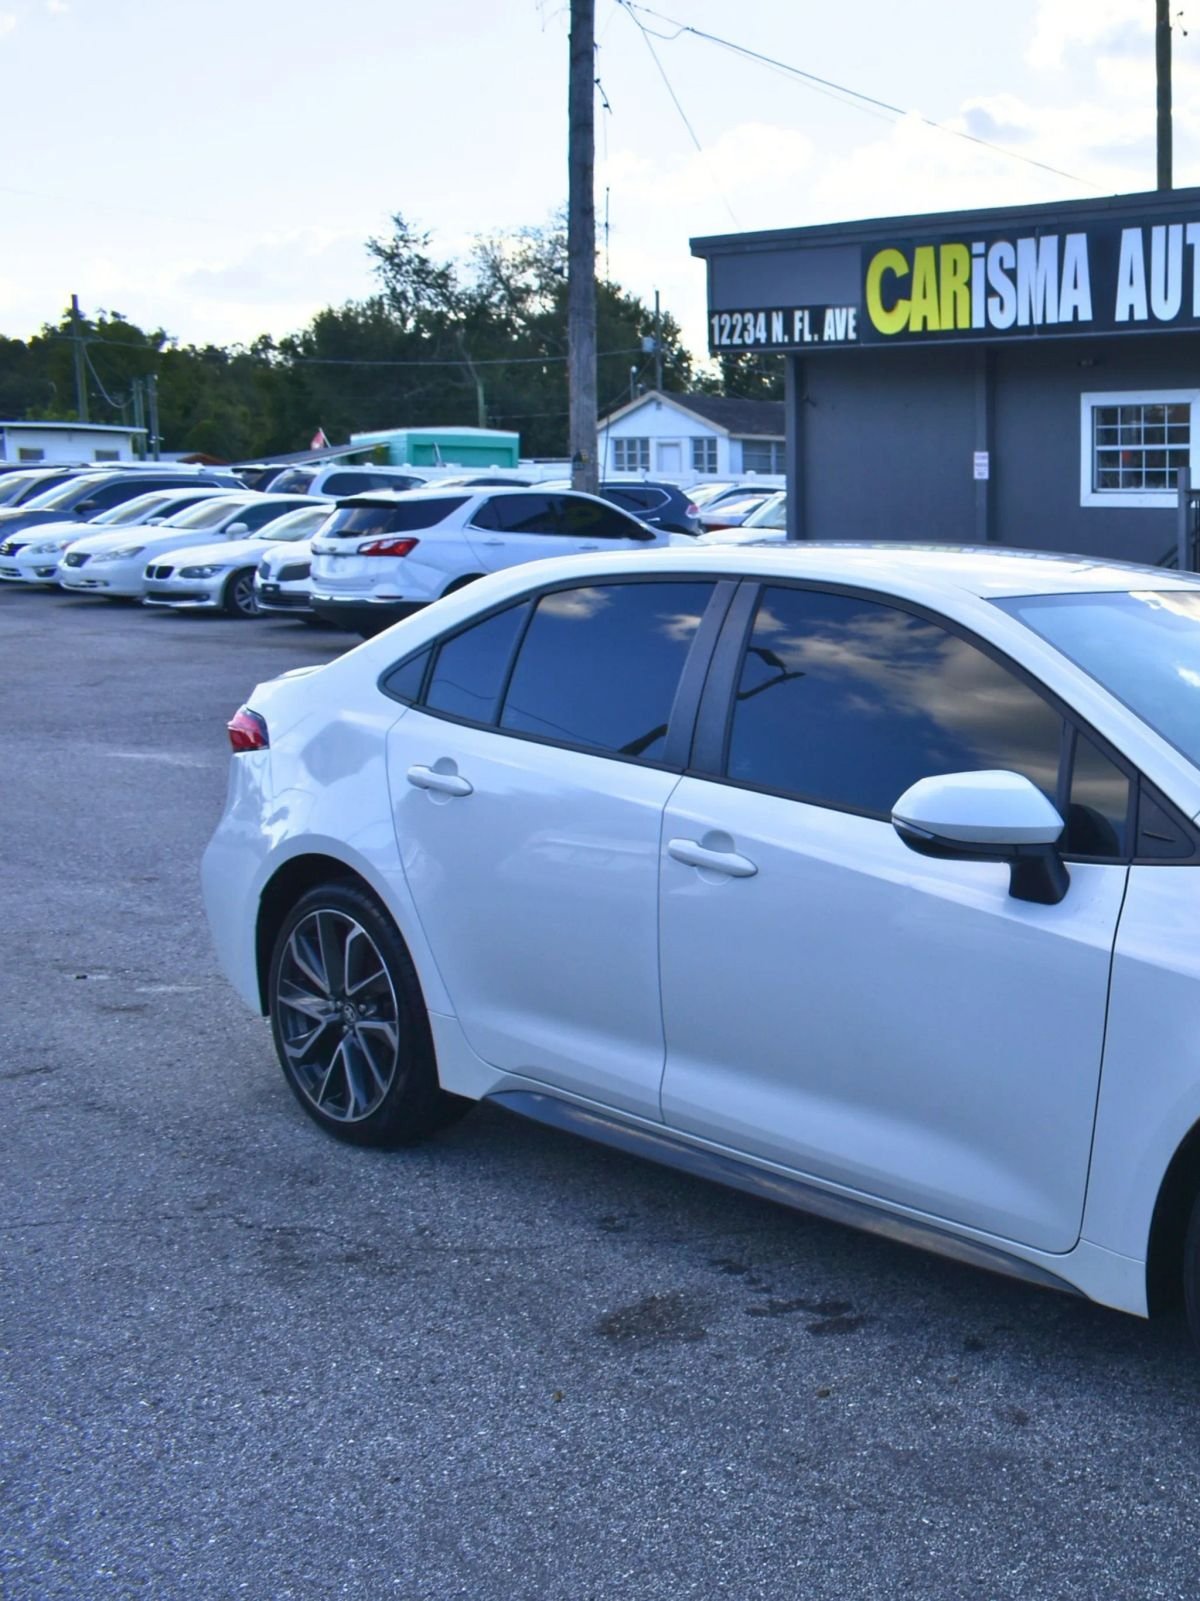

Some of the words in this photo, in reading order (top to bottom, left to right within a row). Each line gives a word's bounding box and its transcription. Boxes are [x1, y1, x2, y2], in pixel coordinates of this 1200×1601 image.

[711, 313, 767, 345] 12234
[772, 311, 789, 343] N.
[794, 309, 819, 342] FL.
[823, 308, 857, 341] AVE
